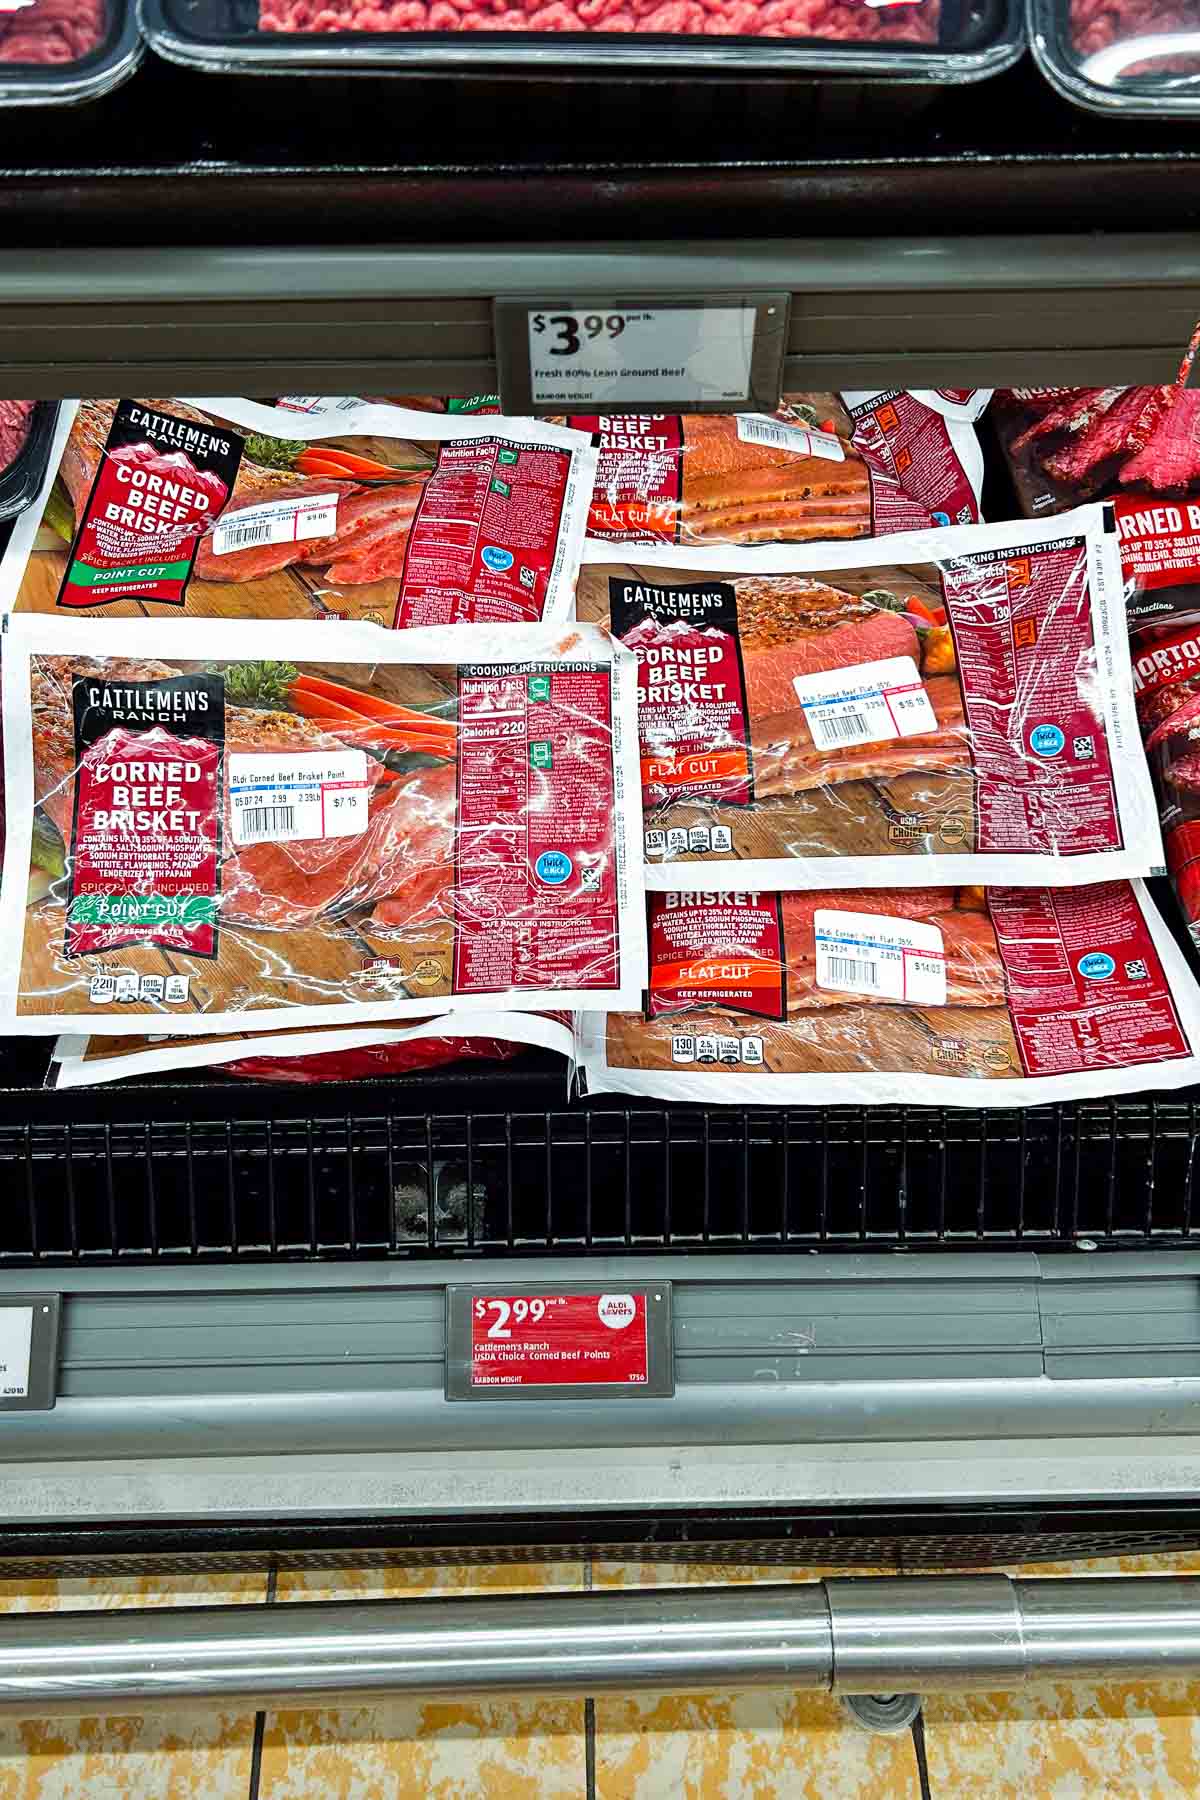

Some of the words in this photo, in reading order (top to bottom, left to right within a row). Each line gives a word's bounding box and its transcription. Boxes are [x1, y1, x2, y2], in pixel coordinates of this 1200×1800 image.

[534, 368, 562, 378] Fresh
[565, 368, 591, 378] 80%
[594, 368, 618, 378] Lean
[620, 367, 659, 378] Ground
[661, 367, 685, 377] Beef
[599, 416, 651, 434] BEEF
[129, 408, 231, 456] CATTLEMEN'S
[146, 430, 208, 458] RANCH
[450, 436, 491, 447] COOKING
[492, 437, 561, 453] INSTRUCTIONS
[600, 433, 668, 451] RISKET
[442, 449, 474, 458] Nutrition
[475, 446, 495, 456] Facts
[116, 466, 210, 511] CORNED
[127, 490, 190, 522] BEEF
[105, 503, 200, 535] BRISKET
[595, 510, 624, 521] FLAT
[628, 510, 650, 523] CUT
[997, 539, 1073, 559] INSTRUCTIONS
[1131, 542, 1142, 551] UP
[1144, 541, 1153, 549] TO
[1154, 539, 1173, 548] 35%
[1133, 561, 1162, 573] SODIUM
[93, 569, 135, 581] POINT
[137, 567, 167, 576] CUT
[91, 587, 109, 595] KEEP
[110, 582, 158, 593] REFRIGERATED
[623, 586, 723, 608] CATTLEMEN'S
[644, 603, 704, 616] RANCH
[993, 606, 1009, 619] 130
[633, 646, 723, 665] CORNED
[470, 665, 516, 676] COOKING
[519, 663, 597, 674] INSTRUCTIONS
[649, 664, 707, 683] BEEF
[463, 681, 499, 693] Nutrition
[500, 679, 524, 690] Facts
[89, 688, 209, 711] CATTLEMEN'S
[637, 683, 726, 704] BRISKET
[113, 710, 186, 722] RANCH
[463, 727, 499, 736] Calories
[502, 722, 525, 734] 220
[96, 762, 201, 783] CORNED
[649, 764, 684, 776] FLAT
[690, 760, 718, 772] CUT
[250, 774, 275, 782] Corned
[278, 772, 294, 781] Beef
[298, 772, 323, 781] Brisket
[327, 770, 345, 779] Point
[112, 785, 182, 806] BEEF
[93, 810, 201, 831] BRISKET
[118, 853, 172, 861] ERYTHORBATE,
[92, 861, 124, 869] NITRITE,
[99, 870, 144, 878] TENDERIZED
[165, 870, 192, 878] PAPAIN
[157, 883, 209, 892] INCLUDED
[665, 891, 760, 909] BRISKET
[99, 903, 151, 916] POINT
[657, 910, 688, 921] CONTAINS
[689, 909, 699, 917] UP
[739, 909, 771, 917] SOLUTION
[662, 918, 685, 927] WATER,
[732, 916, 776, 925] PHOSPHATES,
[663, 925, 688, 934] SODIUM
[688, 923, 738, 931] ERYTHORBATE,
[672, 938, 713, 947] TENDERIZED
[657, 952, 684, 962] SPICE
[679, 966, 716, 979] FLAT
[721, 966, 751, 979] CUT
[92, 978, 112, 990] 220
[675, 1038, 692, 1049] 130
[607, 1302, 627, 1310] ALDI
[474, 1343, 522, 1352] Cattlemen's
[523, 1342, 550, 1351] Ranch
[474, 1352, 496, 1361] USDA
[498, 1352, 525, 1361] Choice
[529, 1351, 560, 1360] Corned
[561, 1351, 581, 1360] Beef
[584, 1350, 611, 1359] Points
[474, 1376, 499, 1384] RANDOM
[500, 1375, 523, 1383] WEIGHT
